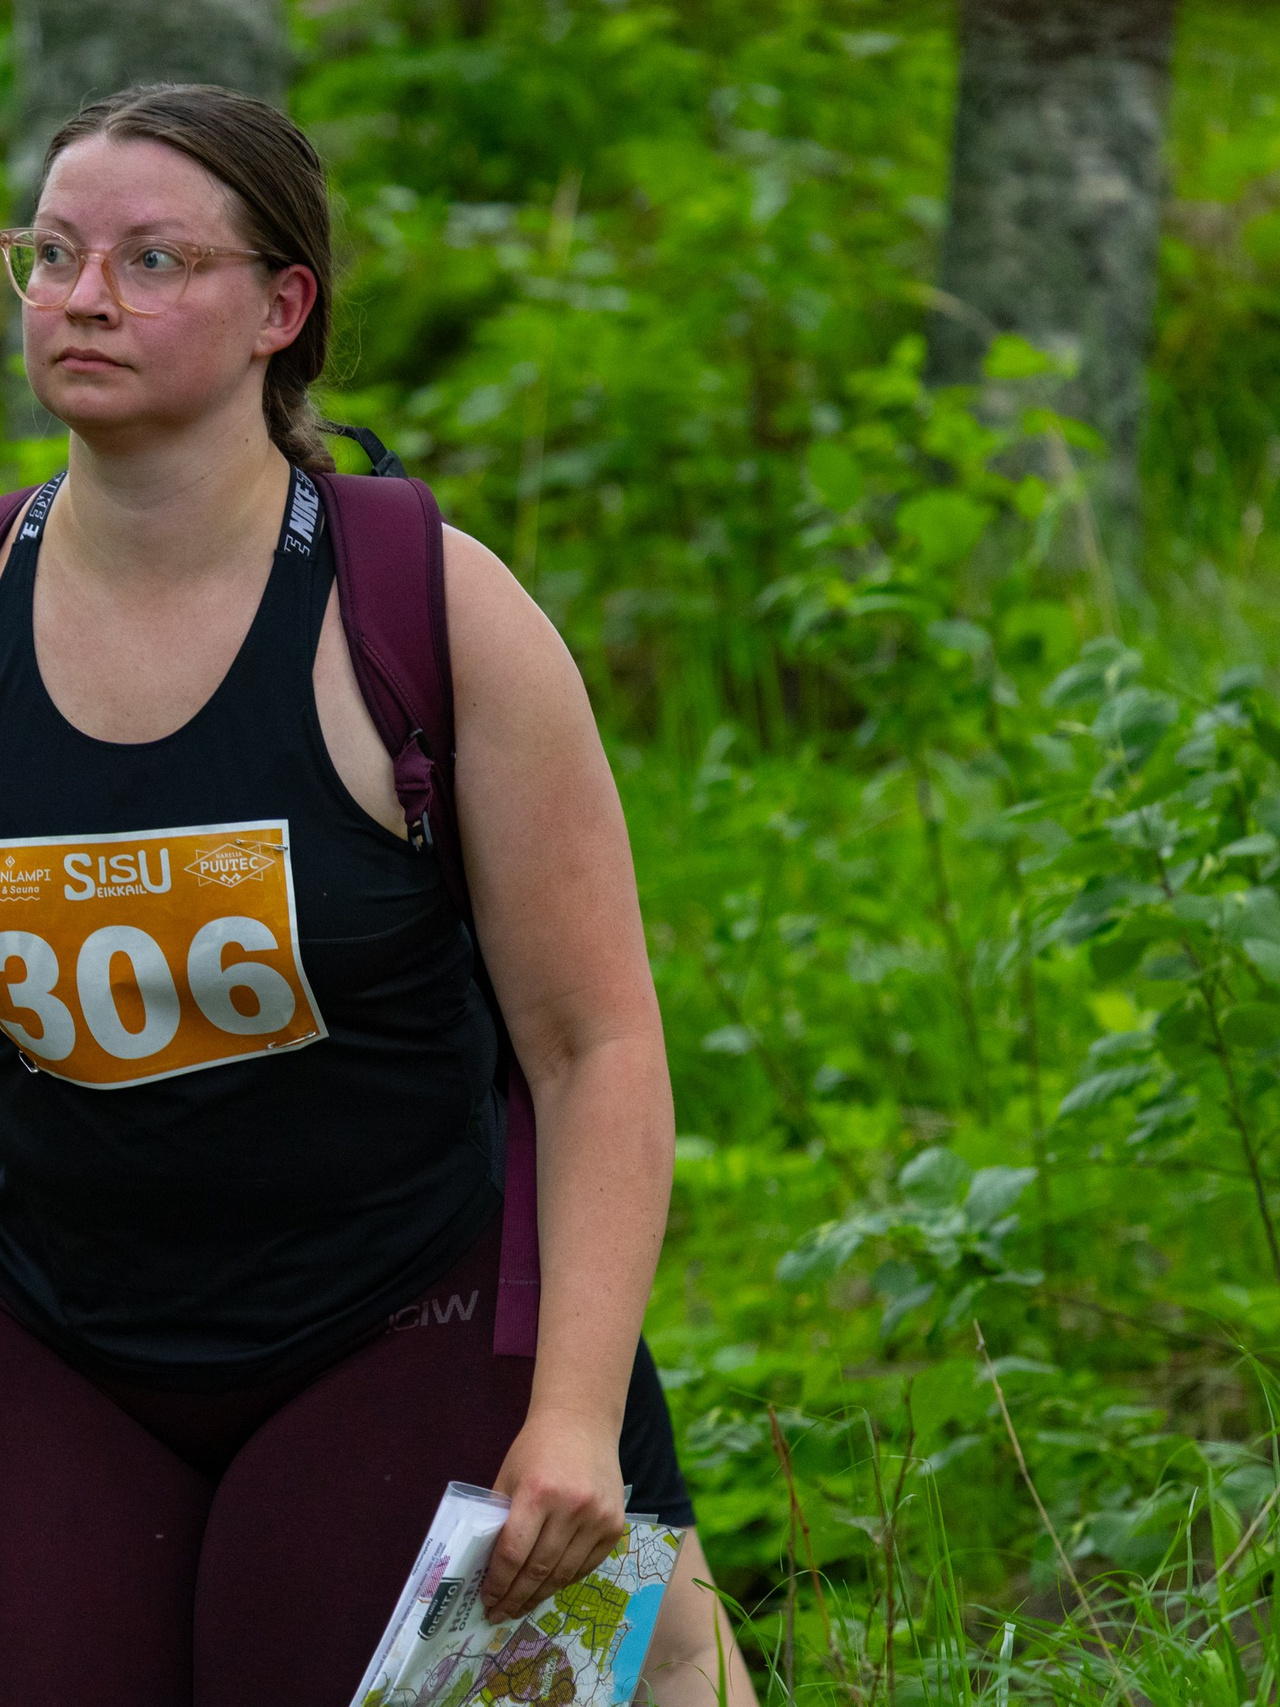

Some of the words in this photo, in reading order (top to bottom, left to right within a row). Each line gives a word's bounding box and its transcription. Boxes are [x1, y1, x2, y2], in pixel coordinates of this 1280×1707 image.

[288, 481, 320, 544] NIKE
[63, 848, 172, 901] SISU
[200, 856, 259, 874] PUUTEC
[2, 885, 8, 895] &
[10, 885, 40, 894] Sauna
